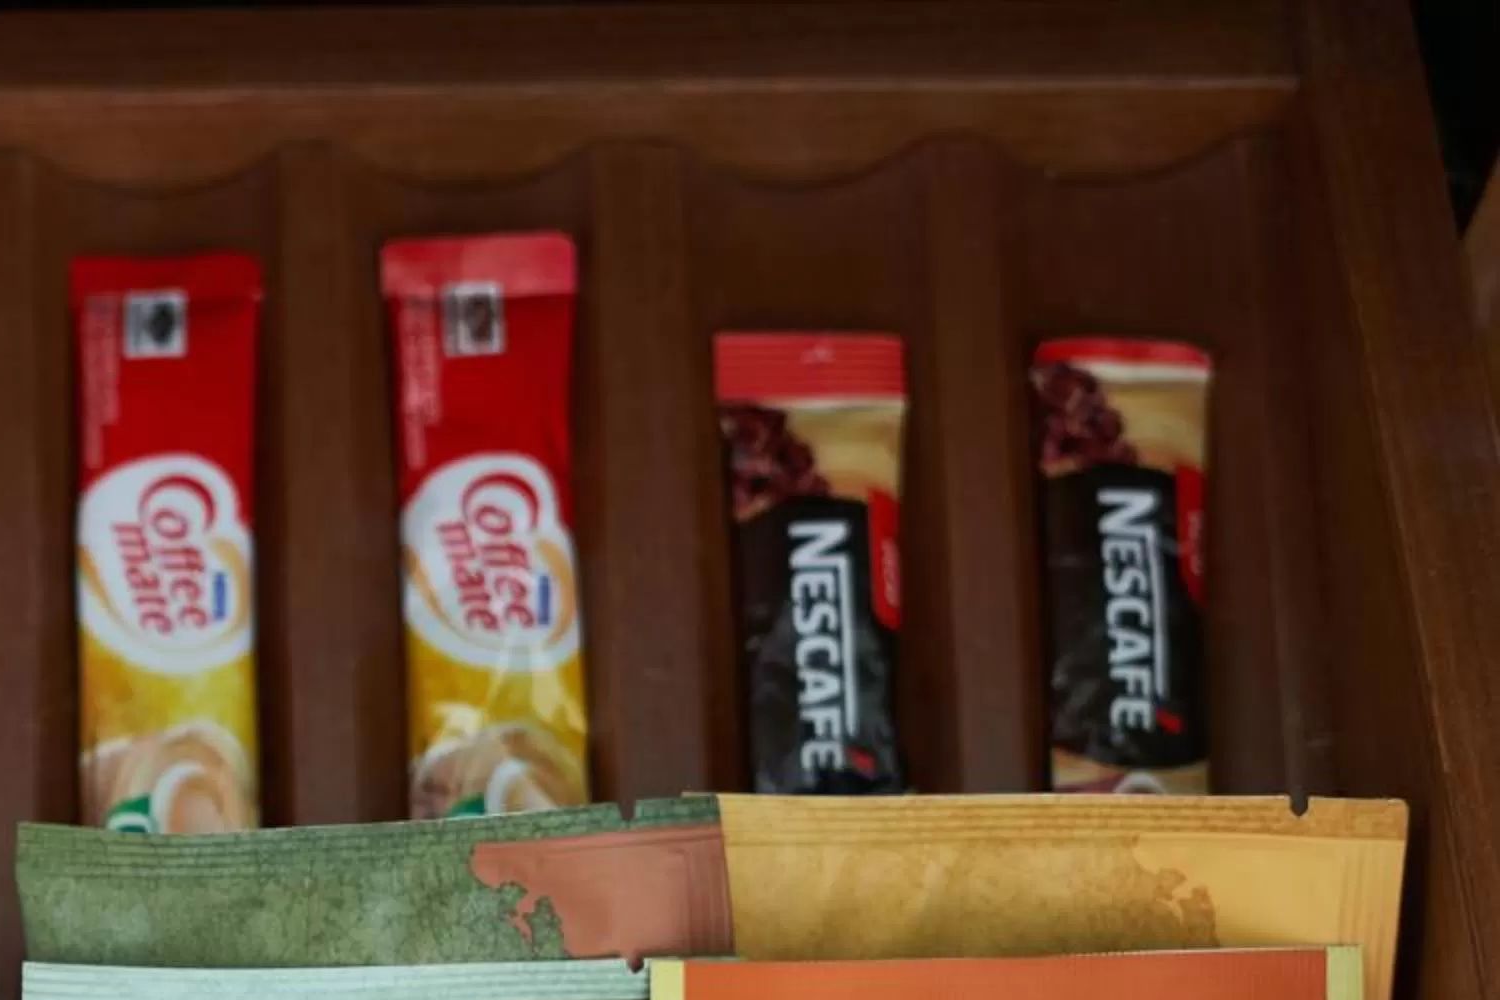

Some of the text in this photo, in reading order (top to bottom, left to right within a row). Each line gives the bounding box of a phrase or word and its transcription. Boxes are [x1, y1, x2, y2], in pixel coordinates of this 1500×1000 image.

[111, 523, 173, 634] mate
[139, 473, 216, 630] Coffee
[437, 523, 499, 632] mate
[462, 473, 540, 629] Coffee
